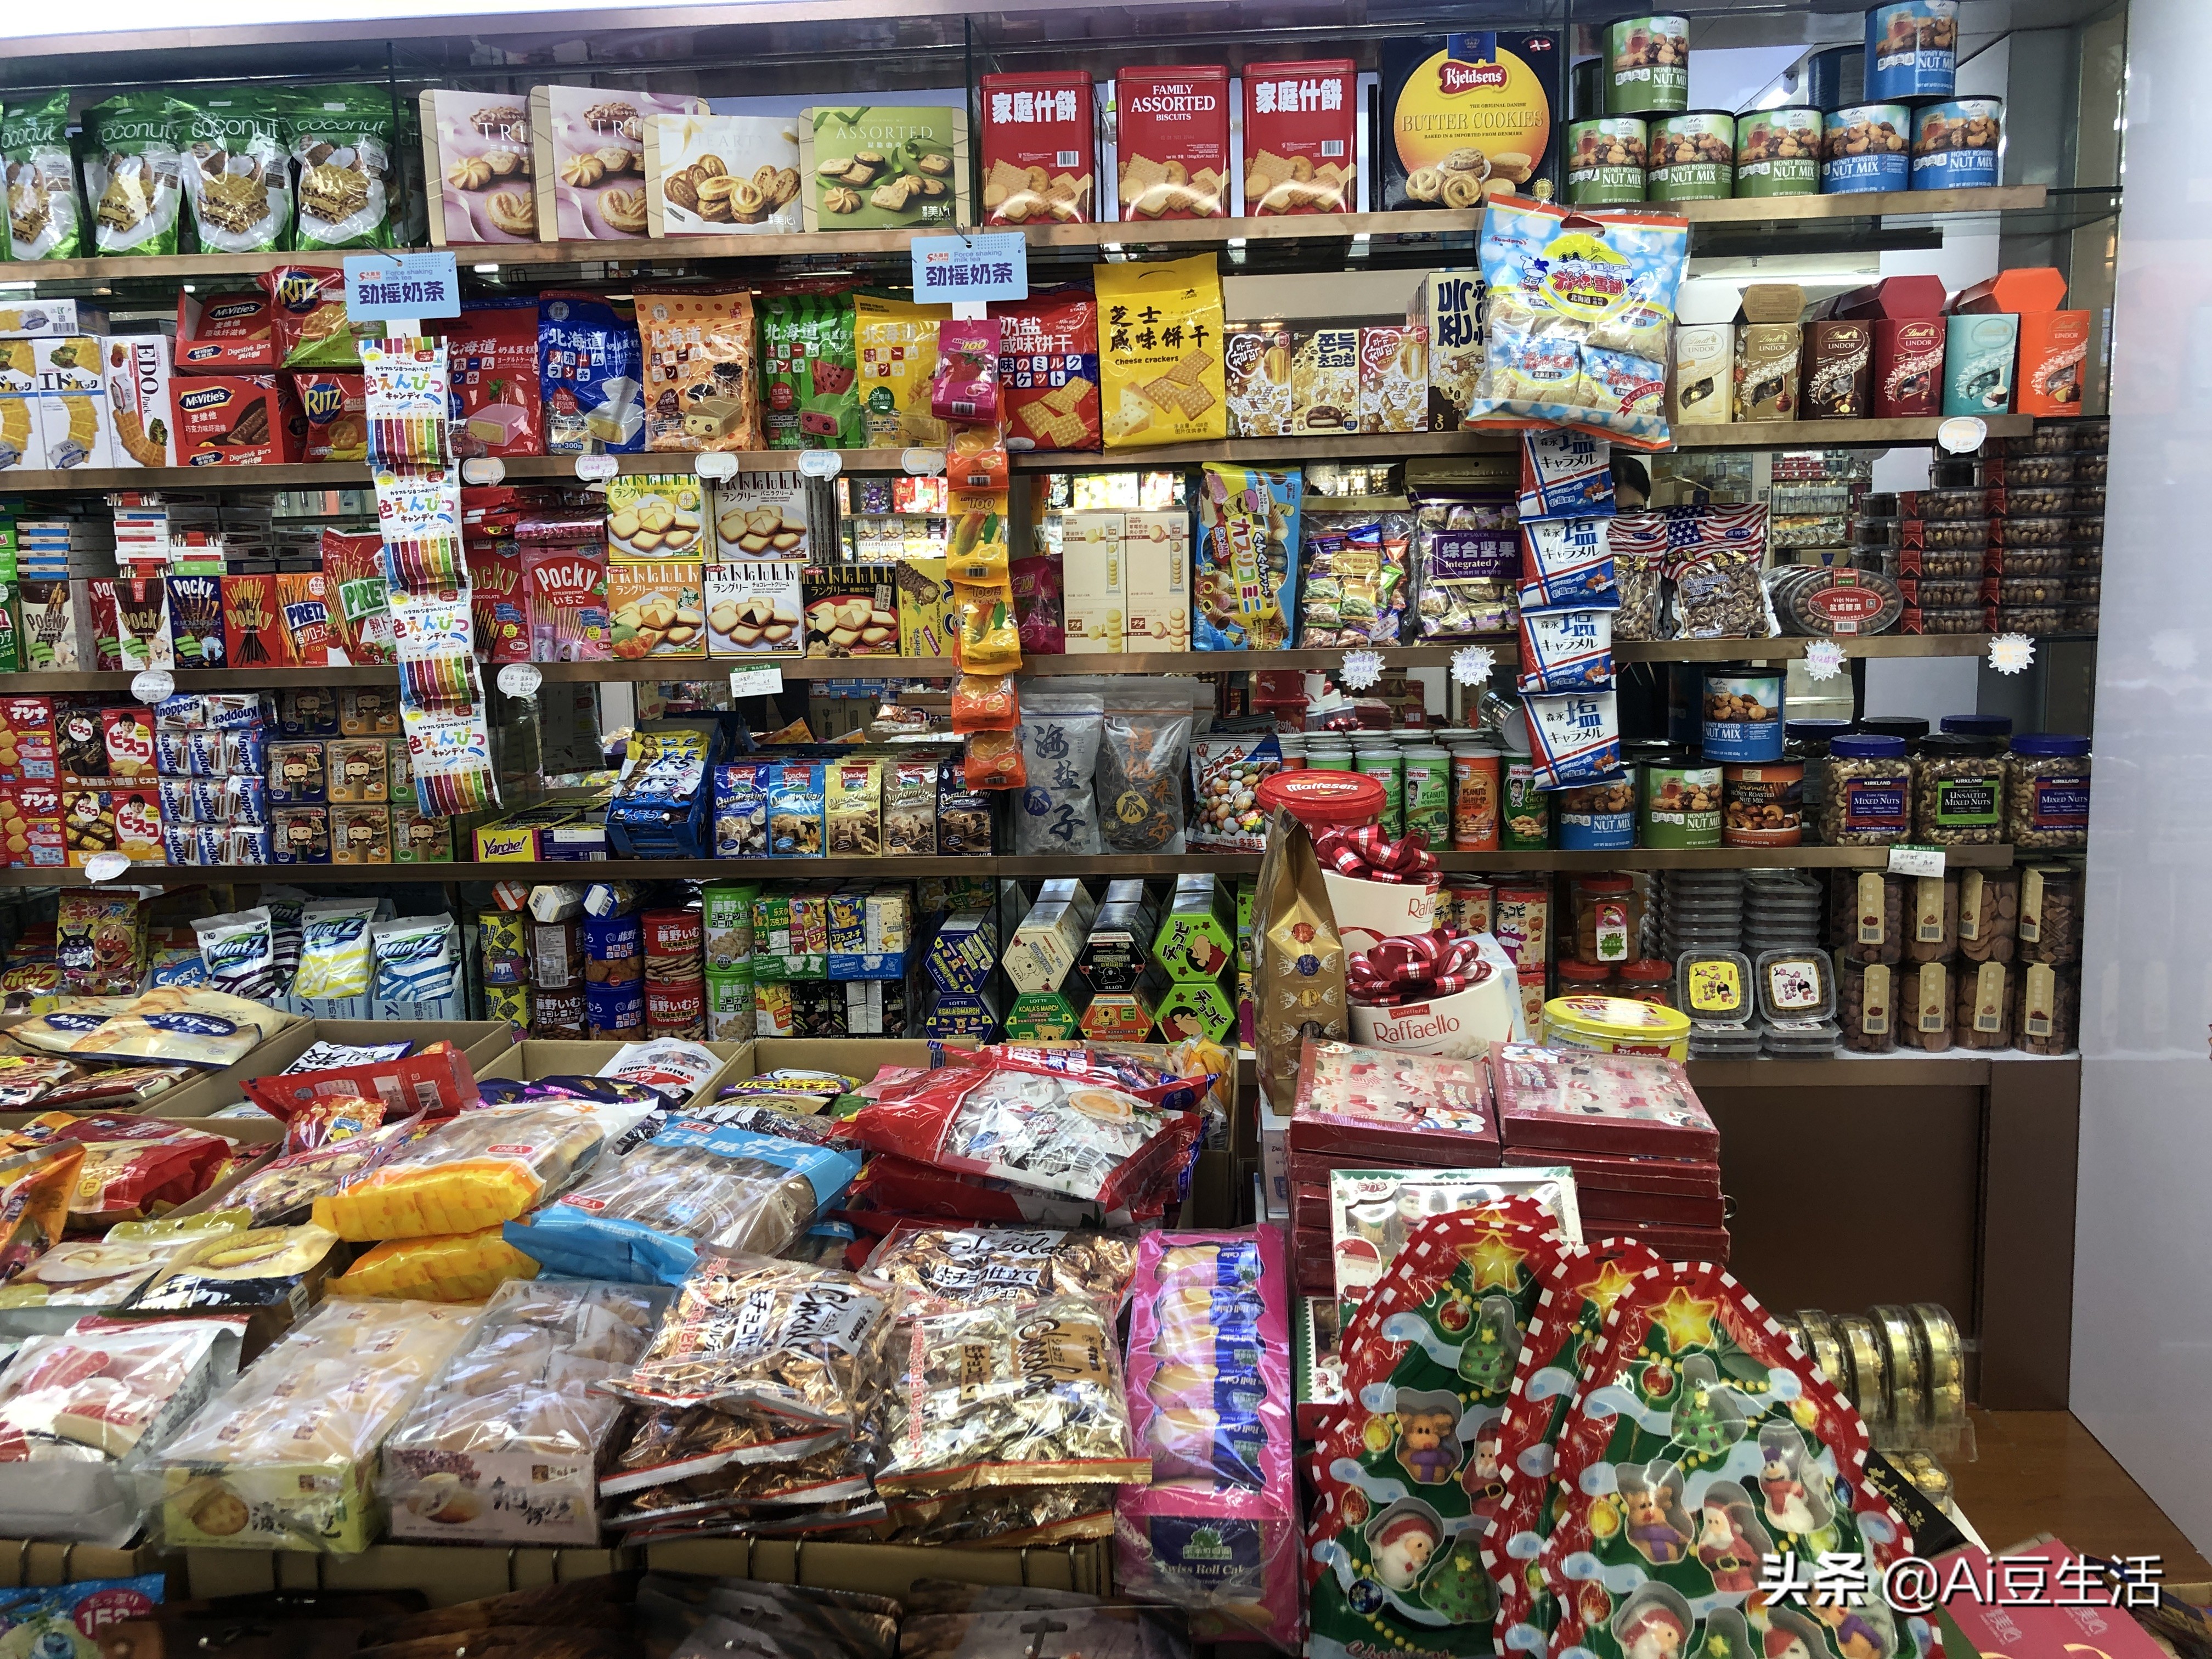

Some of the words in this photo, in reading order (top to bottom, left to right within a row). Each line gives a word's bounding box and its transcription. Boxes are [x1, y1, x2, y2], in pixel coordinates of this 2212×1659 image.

[1443, 67, 1504, 85] Kjeldsens
[1153, 85, 1193, 94] FAMILY
[1256, 80, 1342, 113] 家庭什餅
[992, 90, 1076, 123] 家庭什餅
[1131, 95, 1215, 112] ASSORTED
[1155, 113, 1192, 121] BISCUITS
[1402, 115, 1468, 132] BUTTER
[1474, 110, 1543, 127] COOKIES
[836, 126, 933, 139] ASSORTED
[1671, 172, 1690, 183] NUT
[1694, 171, 1716, 182] MIX
[1773, 167, 1793, 178] NUT
[1796, 166, 1814, 177] MIX
[1832, 165, 1853, 177] NUT
[1857, 161, 1878, 173] MIX
[1602, 173, 1622, 184] NUT
[1624, 173, 1641, 184] MIX
[927, 263, 1013, 286] 劲摇奶茶
[280, 278, 319, 304] RITZ
[359, 281, 444, 304] 劲摇奶茶
[1110, 307, 1161, 325] 芝士
[136, 344, 158, 396] EDO
[1116, 357, 1142, 365] Cheese
[40, 371, 72, 390] エド
[76, 379, 98, 390] パック
[142, 396, 150, 415] Pack
[186, 391, 225, 408] McVitie's
[304, 390, 341, 415] RITZ
[722, 493, 757, 502] ラングリー
[1442, 542, 1515, 557] 综合坚果
[708, 564, 796, 582] LANGULY
[805, 567, 894, 585] LANGULY
[713, 583, 748, 592] ラングリー
[554, 595, 584, 605] いちご
[924, 631, 939, 653] Banana
[11, 707, 48, 719] マンナ
[159, 699, 200, 717] noppers
[21, 794, 57, 806] マンナ
[483, 837, 527, 857] Yarche!
[1373, 1014, 1460, 1043] Raffaello
